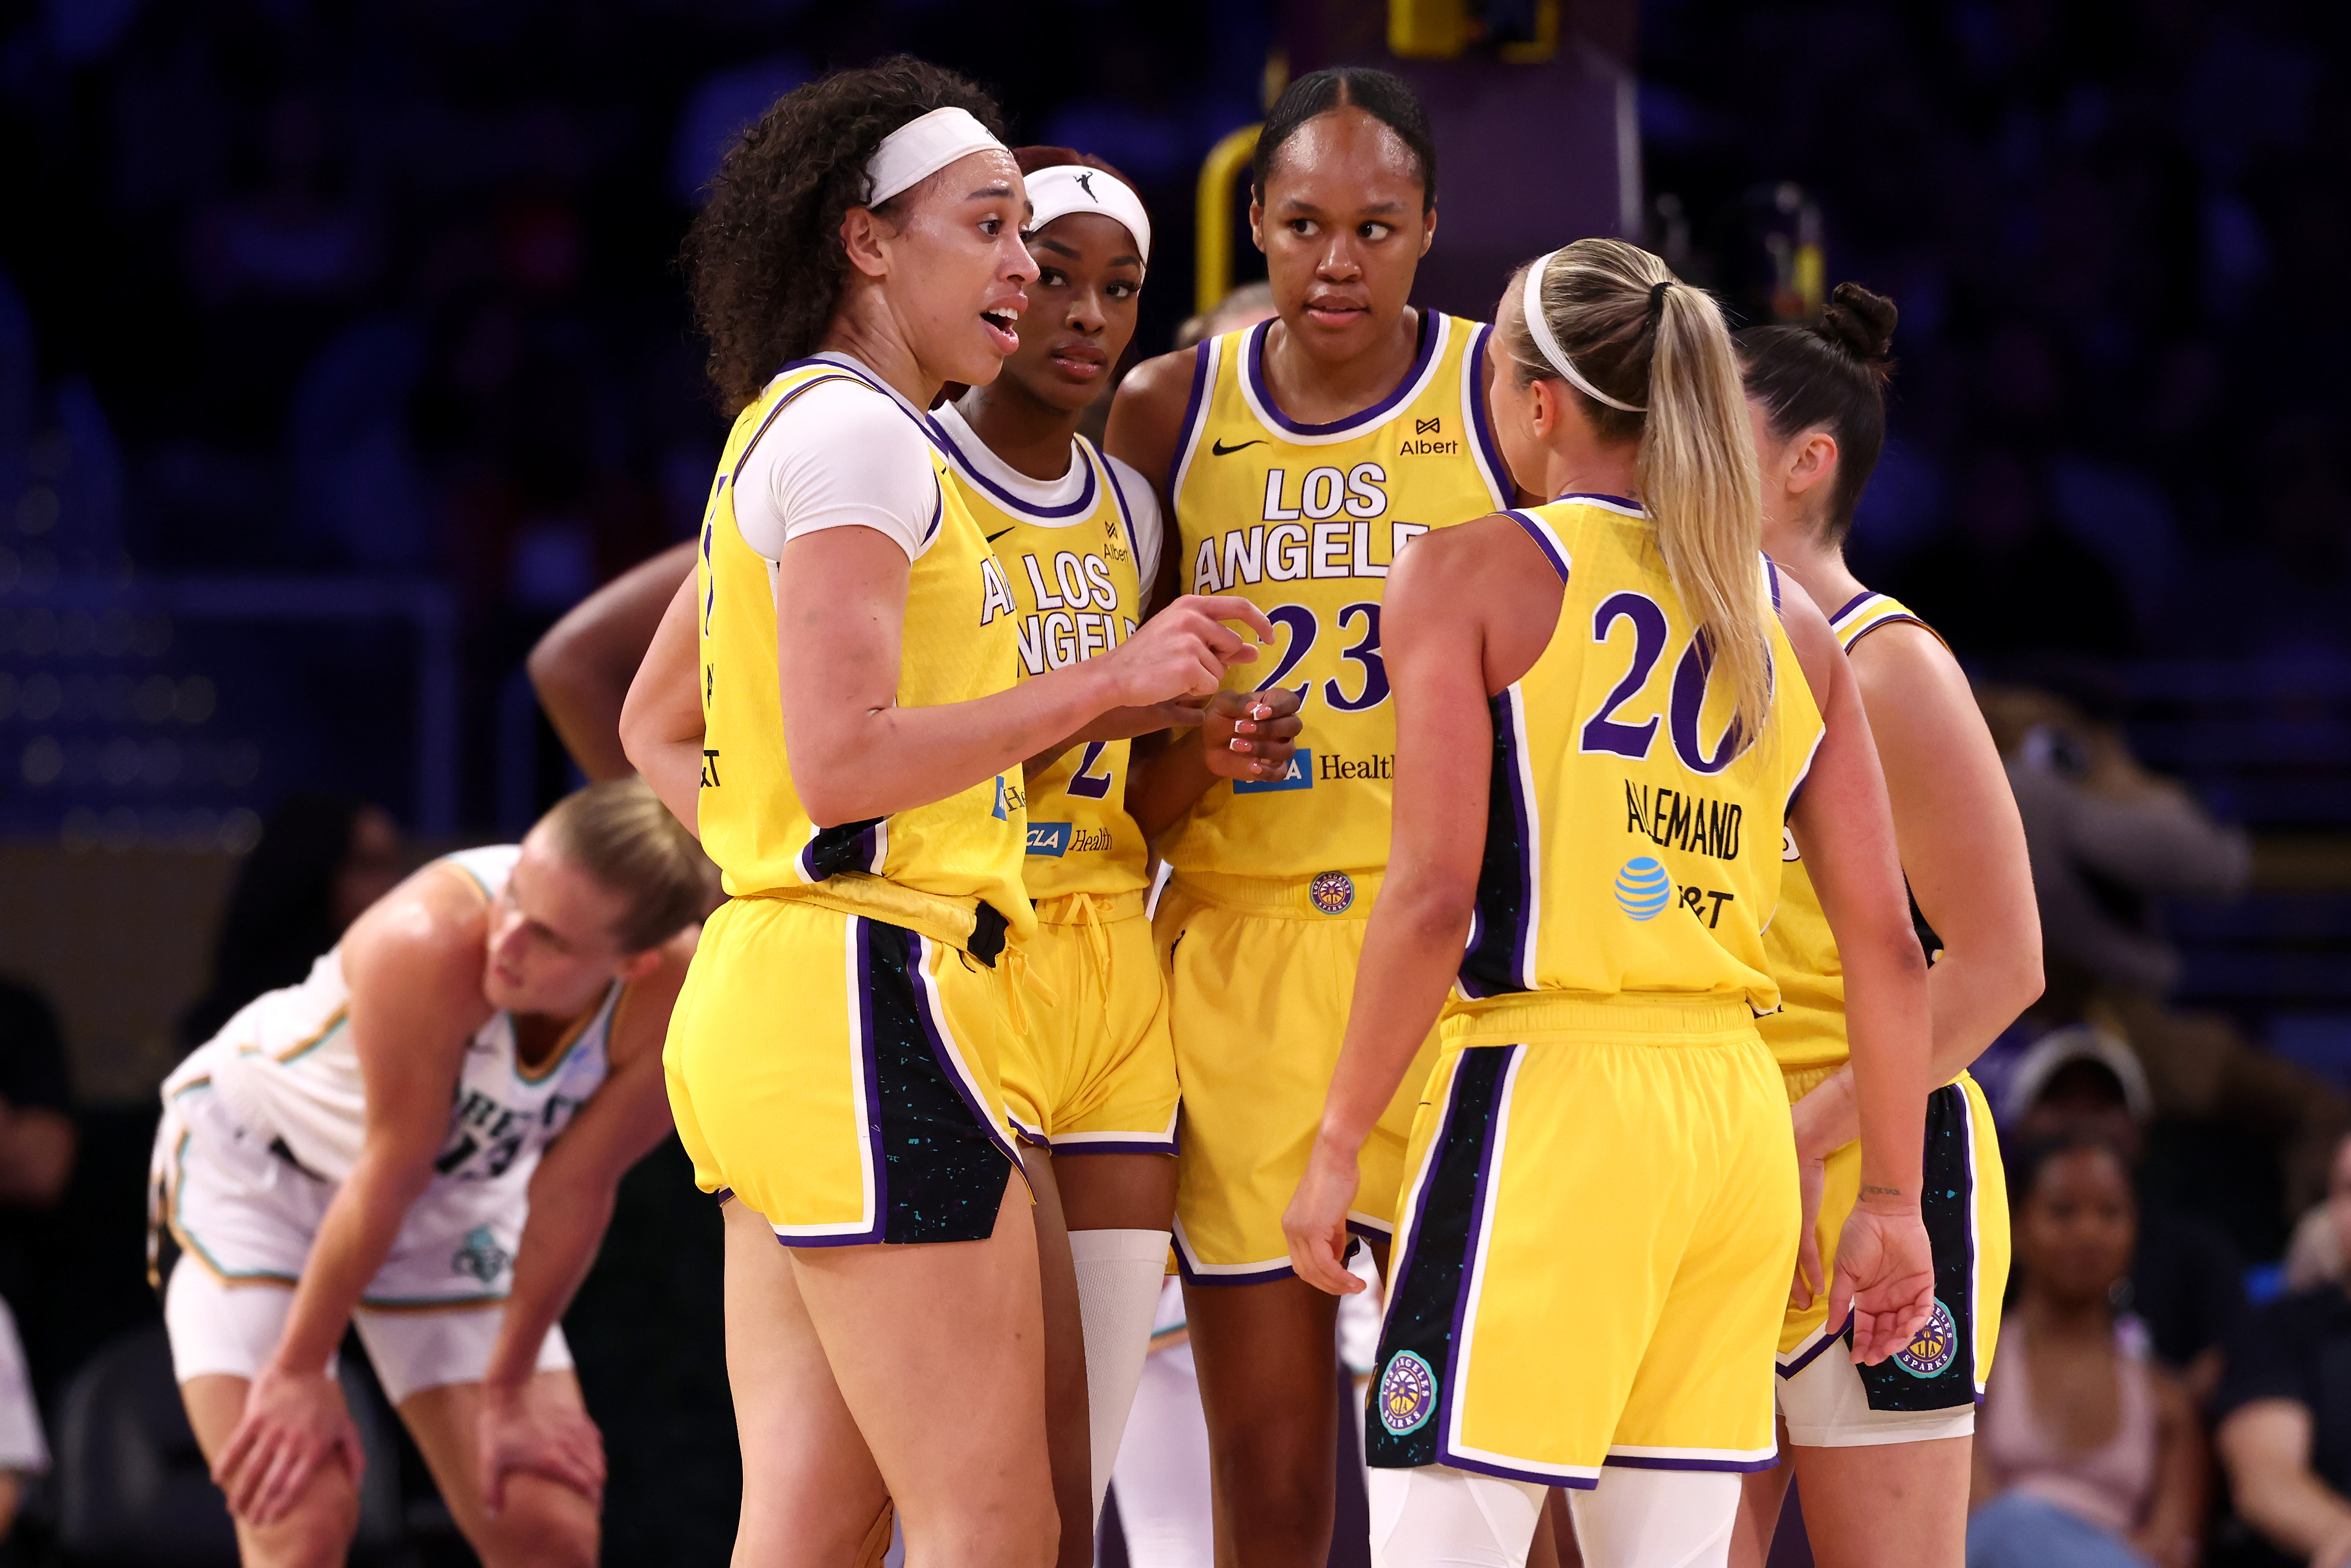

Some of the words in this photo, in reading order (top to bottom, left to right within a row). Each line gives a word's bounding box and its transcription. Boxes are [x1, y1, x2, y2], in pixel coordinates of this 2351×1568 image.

[1400, 439, 1458, 456] Albert
[1262, 462, 1387, 521] LOS
[1104, 543, 1129, 563] Albert
[1193, 521, 1430, 596] ANGEL
[1022, 551, 1117, 612] LOS
[1252, 600, 1392, 713] 23
[1578, 589, 1776, 777] 20
[1026, 830, 1059, 848] CLA
[1068, 827, 1112, 852] Health
[1323, 874, 1351, 894] ANGELES
[1318, 902, 1347, 911] SPARKS
[1903, 1354, 1948, 1371] SPARKS
[1382, 1370, 1394, 1396] LOS
[1395, 1357, 1430, 1397] ANGELES
[1384, 1410, 1421, 1428] SPARKS
